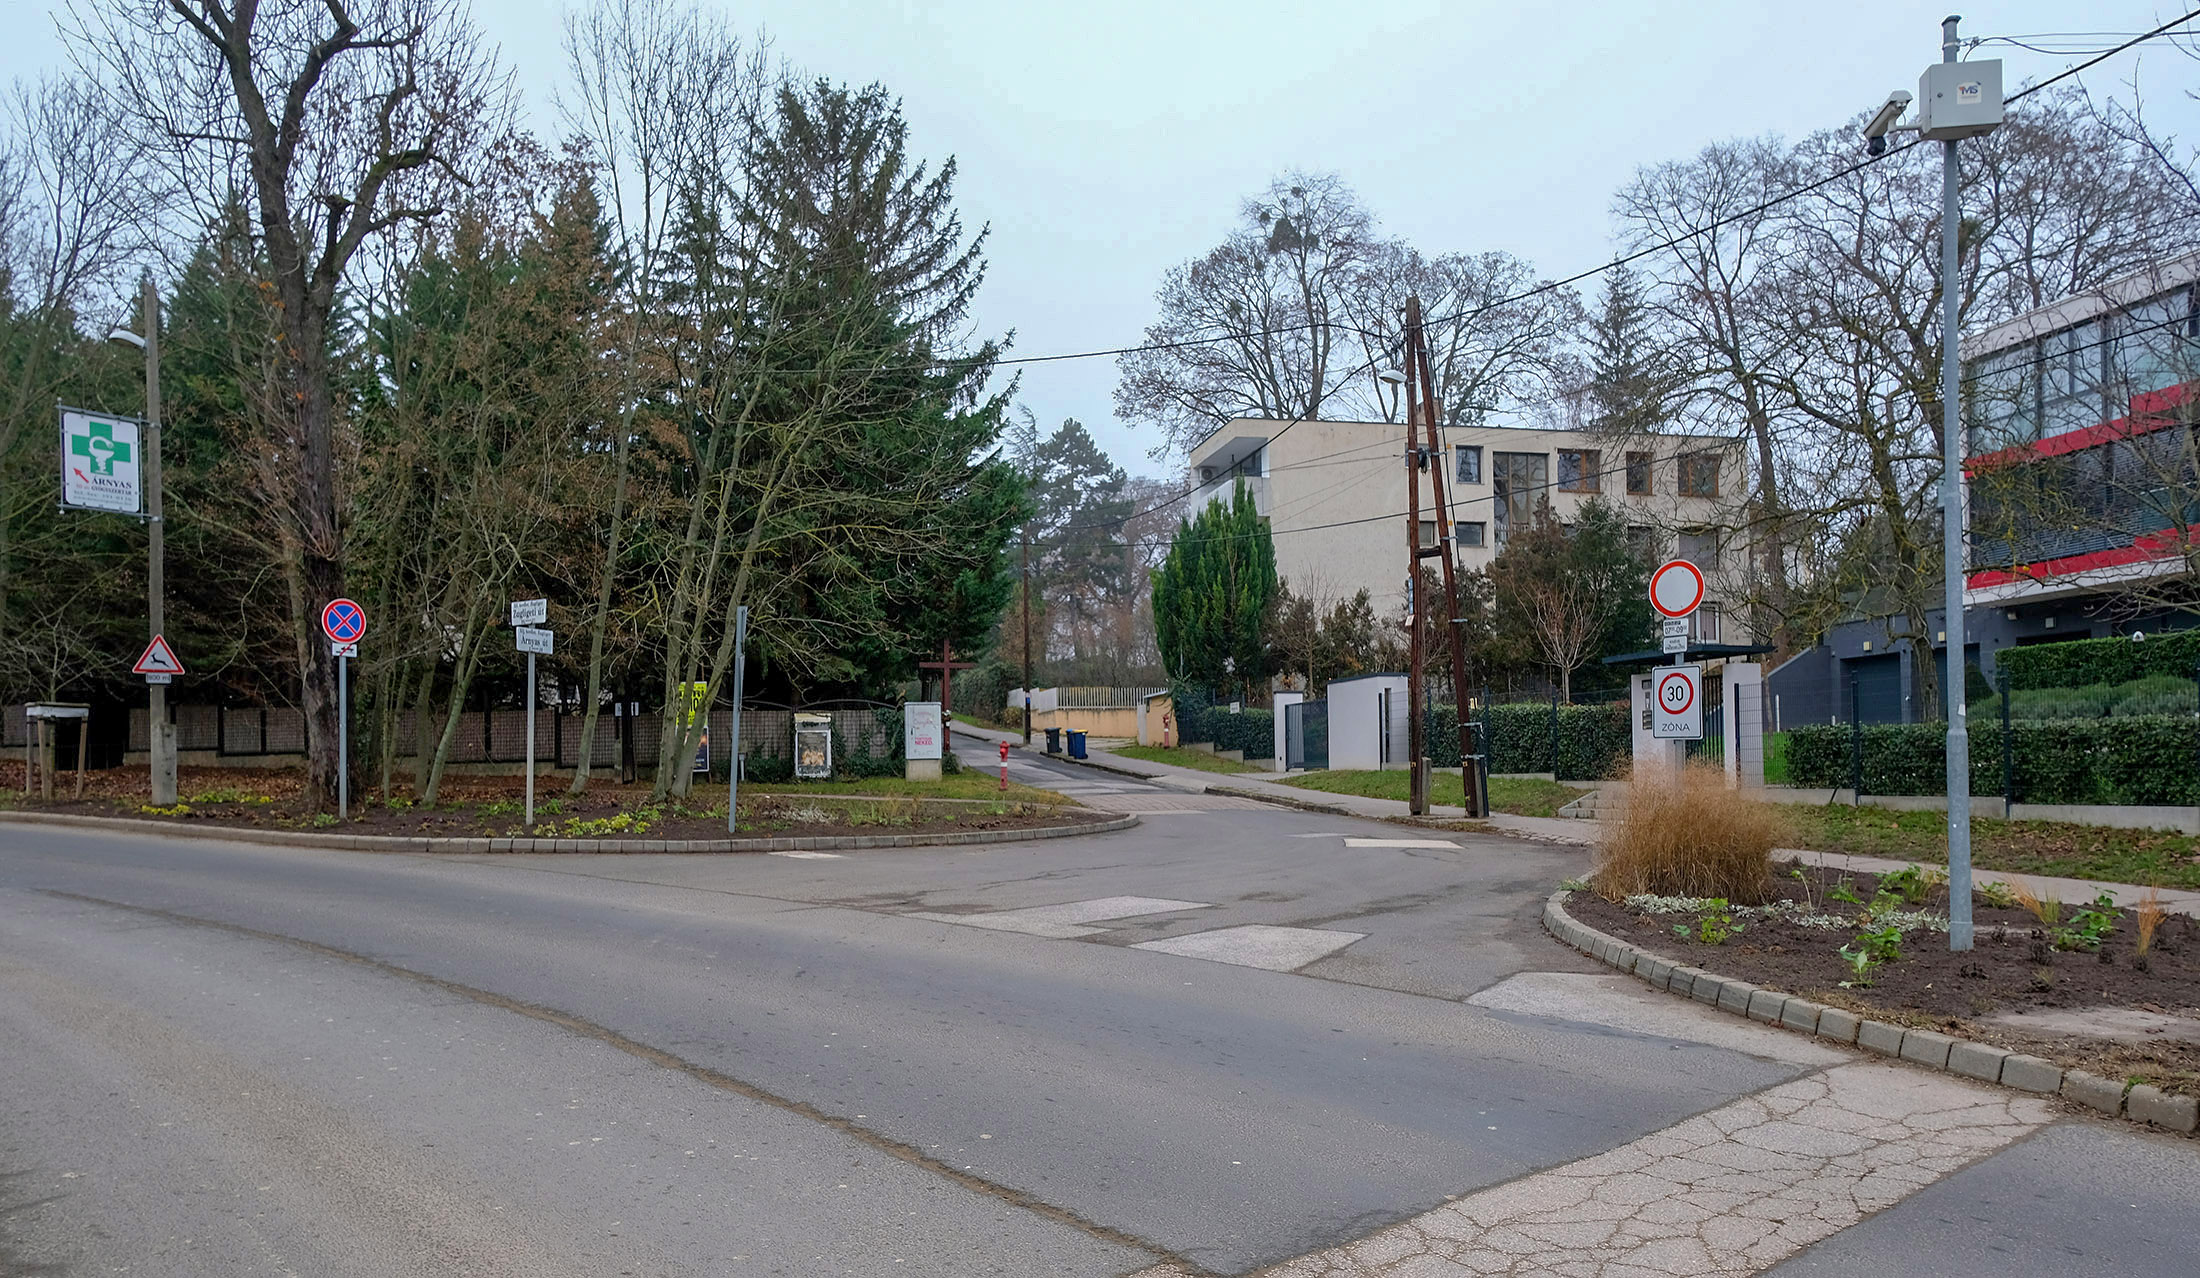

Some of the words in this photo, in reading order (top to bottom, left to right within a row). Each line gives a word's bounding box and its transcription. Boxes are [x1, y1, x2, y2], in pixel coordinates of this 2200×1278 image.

[92, 475, 132, 489] ÁRNYAS
[1667, 685, 1684, 702] 30
[1662, 722, 1690, 732] ZÓNA
